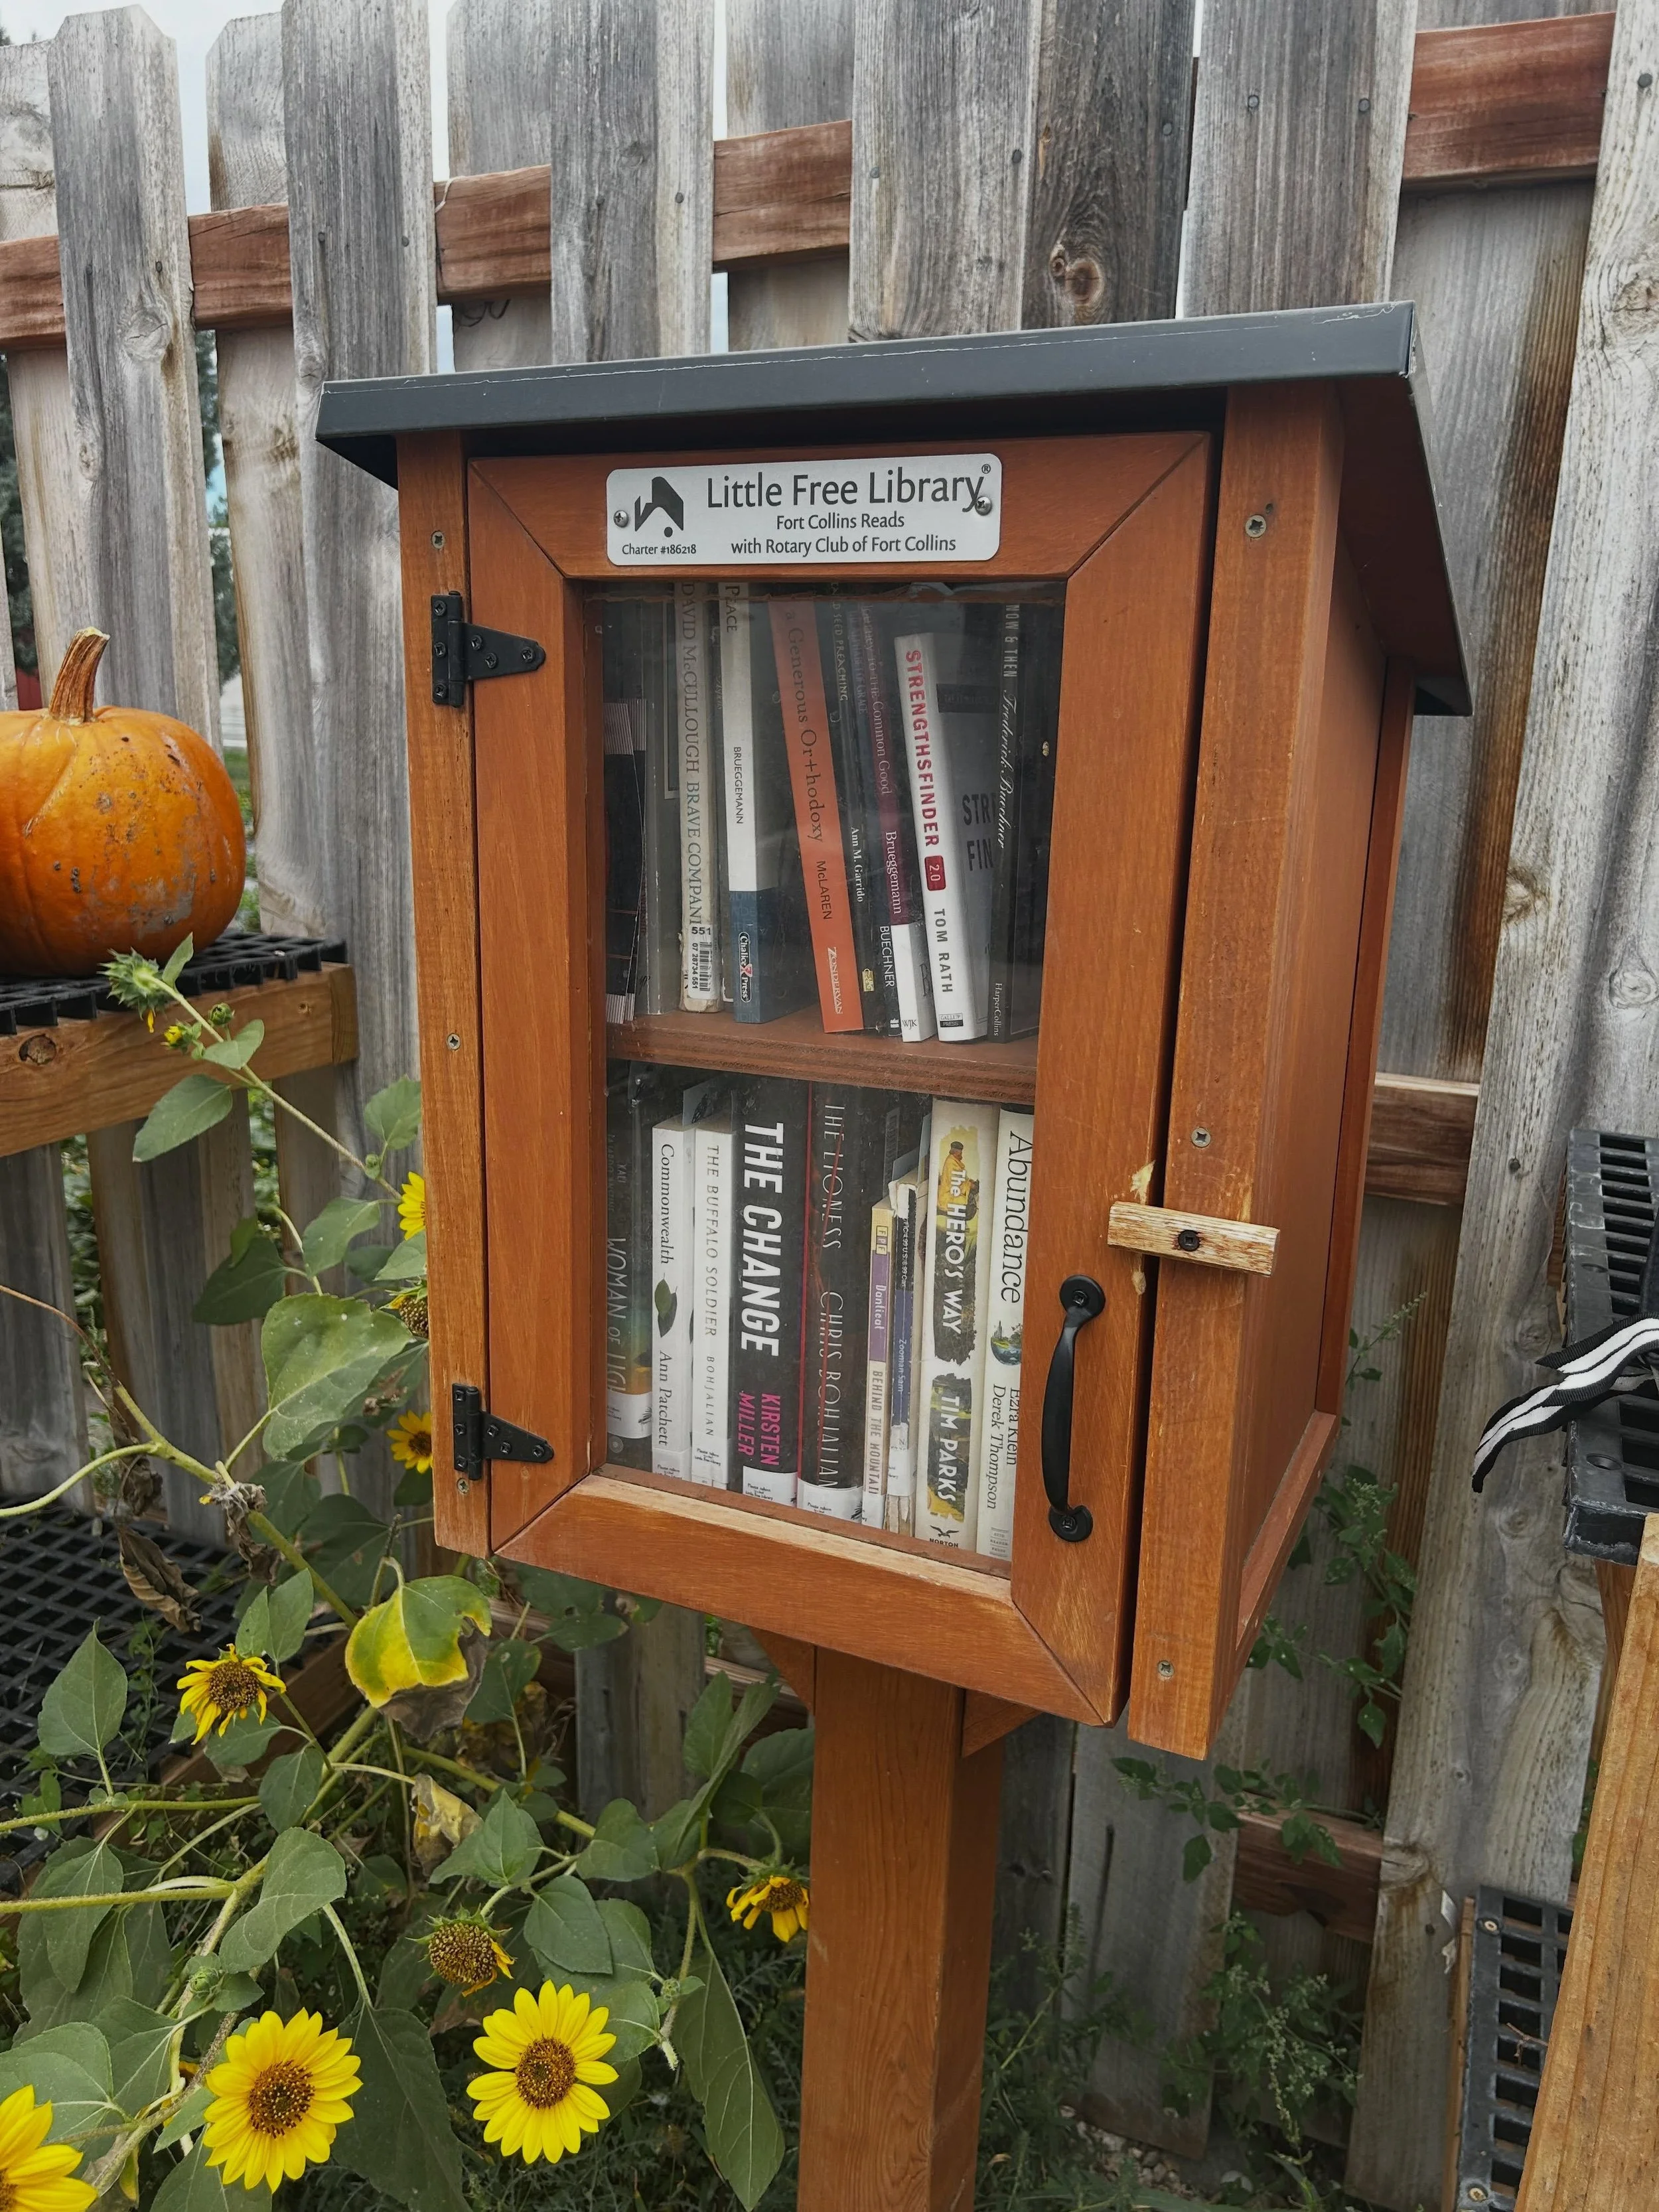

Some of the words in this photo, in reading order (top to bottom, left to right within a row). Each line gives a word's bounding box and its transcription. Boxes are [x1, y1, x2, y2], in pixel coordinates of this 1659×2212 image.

[707, 471, 782, 508] Little
[793, 474, 858, 506] Free
[731, 538, 761, 553] with
[766, 539, 812, 557] Rotary
[816, 536, 849, 552] Club
[852, 536, 868, 552] of
[871, 536, 901, 552] Fort
[904, 534, 956, 552] Collins
[776, 515, 805, 530] Fort
[808, 512, 857, 530] Collins
[861, 510, 904, 528] Reads
[622, 543, 658, 555] Charter
[660, 544, 697, 555] #186218
[681, 582, 697, 640] DAVID
[785, 611, 796, 620] a
[1004, 605, 1020, 630] NOW
[788, 628, 808, 723] Generous
[835, 639, 848, 701] PREACHING
[1003, 649, 1018, 678] THEN
[683, 645, 699, 773] McCULLOUGH
[872, 701, 887, 756] Common
[998, 690, 1017, 773] Frederick
[733, 746, 743, 824] BRUEGGEMANN
[876, 761, 892, 796] Good
[906, 649, 940, 847] STRENGTHSFINDER
[930, 863, 940, 881] 2.0
[686, 782, 701, 839] BRAVE
[851, 826, 861, 846] Ann
[996, 771, 1015, 849] Buechner
[816, 860, 833, 920] McLAREN
[855, 863, 865, 903] Garrido
[885, 830, 902, 915] Brueggemann
[691, 926, 711, 935] 551
[692, 942, 698, 952] 07
[739, 935, 749, 968] Chalice
[934, 909, 948, 942] TOM
[827, 946, 843, 1014] ZONDERVAN
[879, 925, 895, 988] BUECHNER
[939, 952, 953, 993] RATH
[993, 982, 1003, 1037] HarperCollins
[824, 1104, 845, 1142] THE
[616, 1163, 627, 1183] KALI
[707, 1145, 719, 1177] THE
[744, 1122, 784, 1194] THE
[950, 1169, 966, 1197] The
[661, 1143, 675, 1264] Commonwealth
[706, 1184, 719, 1259] BUFFALO
[822, 1151, 845, 1249] LIONESS
[1001, 1130, 1033, 1304] Abundance
[944, 1203, 966, 1279] HERO'S
[607, 1237, 627, 1319] WOMAN
[705, 1266, 718, 1337] SOLDIER
[741, 1204, 782, 1357] CHANGE
[820, 1290, 844, 1361] CHRIS
[874, 1284, 887, 1329] Danticat
[942, 1290, 964, 1335] WAY
[608, 1327, 621, 1345] OF
[898, 1339, 907, 1373] Zooman
[660, 1351, 674, 1382] Ann
[871, 1369, 883, 1412] BEHIND
[897, 1374, 906, 1392] Sam
[658, 1387, 673, 1445] Patchett
[704, 1355, 715, 1436] BOHJALIAN
[940, 1395, 960, 1430] TIM
[991, 1384, 1006, 1428] Derek
[737, 1392, 755, 1457] MILLER
[760, 1393, 781, 1466] KIRSTEN
[870, 1416, 882, 1440] THE
[1006, 1428, 1018, 1466] Klein
[868, 1443, 881, 1495] MOUNTAI
[937, 1438, 959, 1502] PARKS
[987, 1434, 1004, 1509] Thompson
[929, 1537, 959, 1548] NORTON
